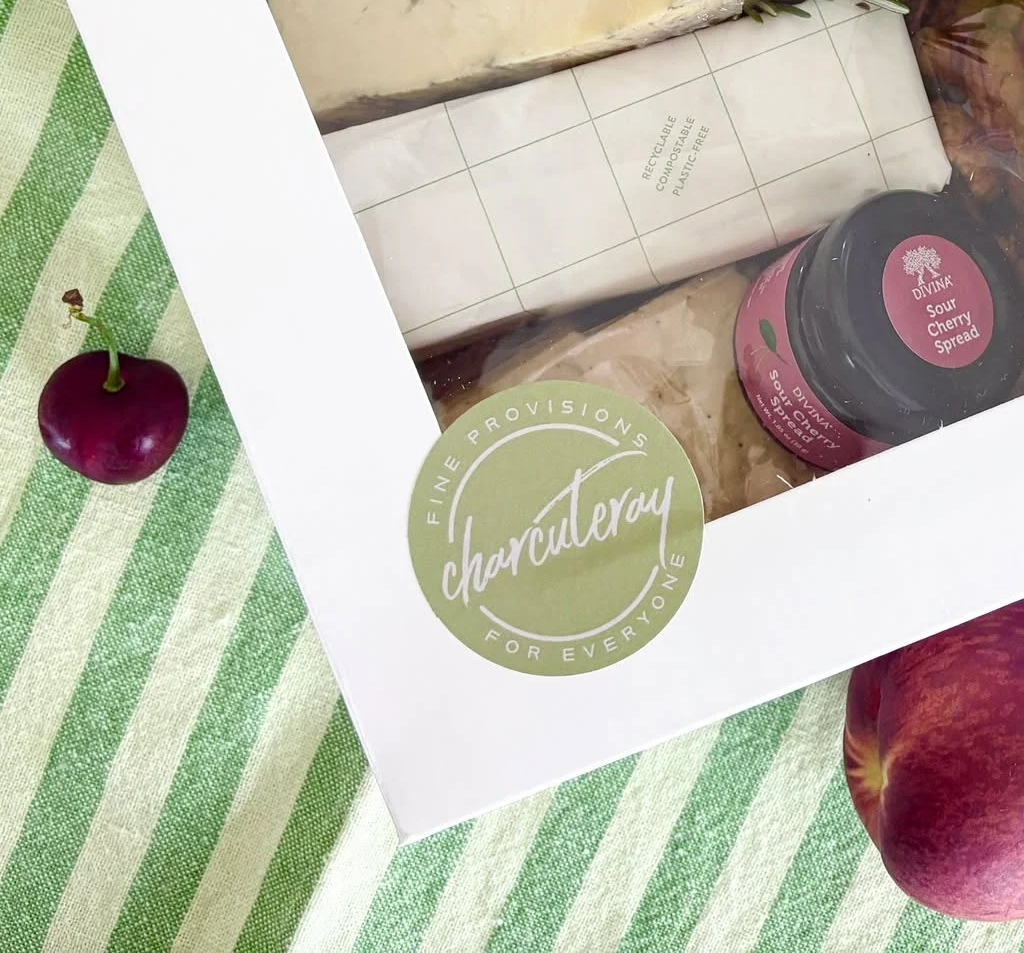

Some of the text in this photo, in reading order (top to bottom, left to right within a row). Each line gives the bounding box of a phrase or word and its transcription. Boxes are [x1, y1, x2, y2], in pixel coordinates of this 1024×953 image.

[642, 115, 677, 180] RECYCLABLE
[655, 117, 696, 192] COMPOSTABLE
[672, 125, 710, 197] PLASTIC-FREE
[912, 275, 953, 300] DIVINA
[926, 298, 957, 318] Sour
[927, 311, 971, 337] Cherry
[934, 324, 980, 354] Spread
[769, 369, 840, 449] Sour Cherry
[770, 396, 814, 443] Spread
[427, 399, 648, 525] FINE PROVISIONS
[441, 449, 675, 607] charcuteray
[485, 552, 686, 662] FOR EVERYONE
